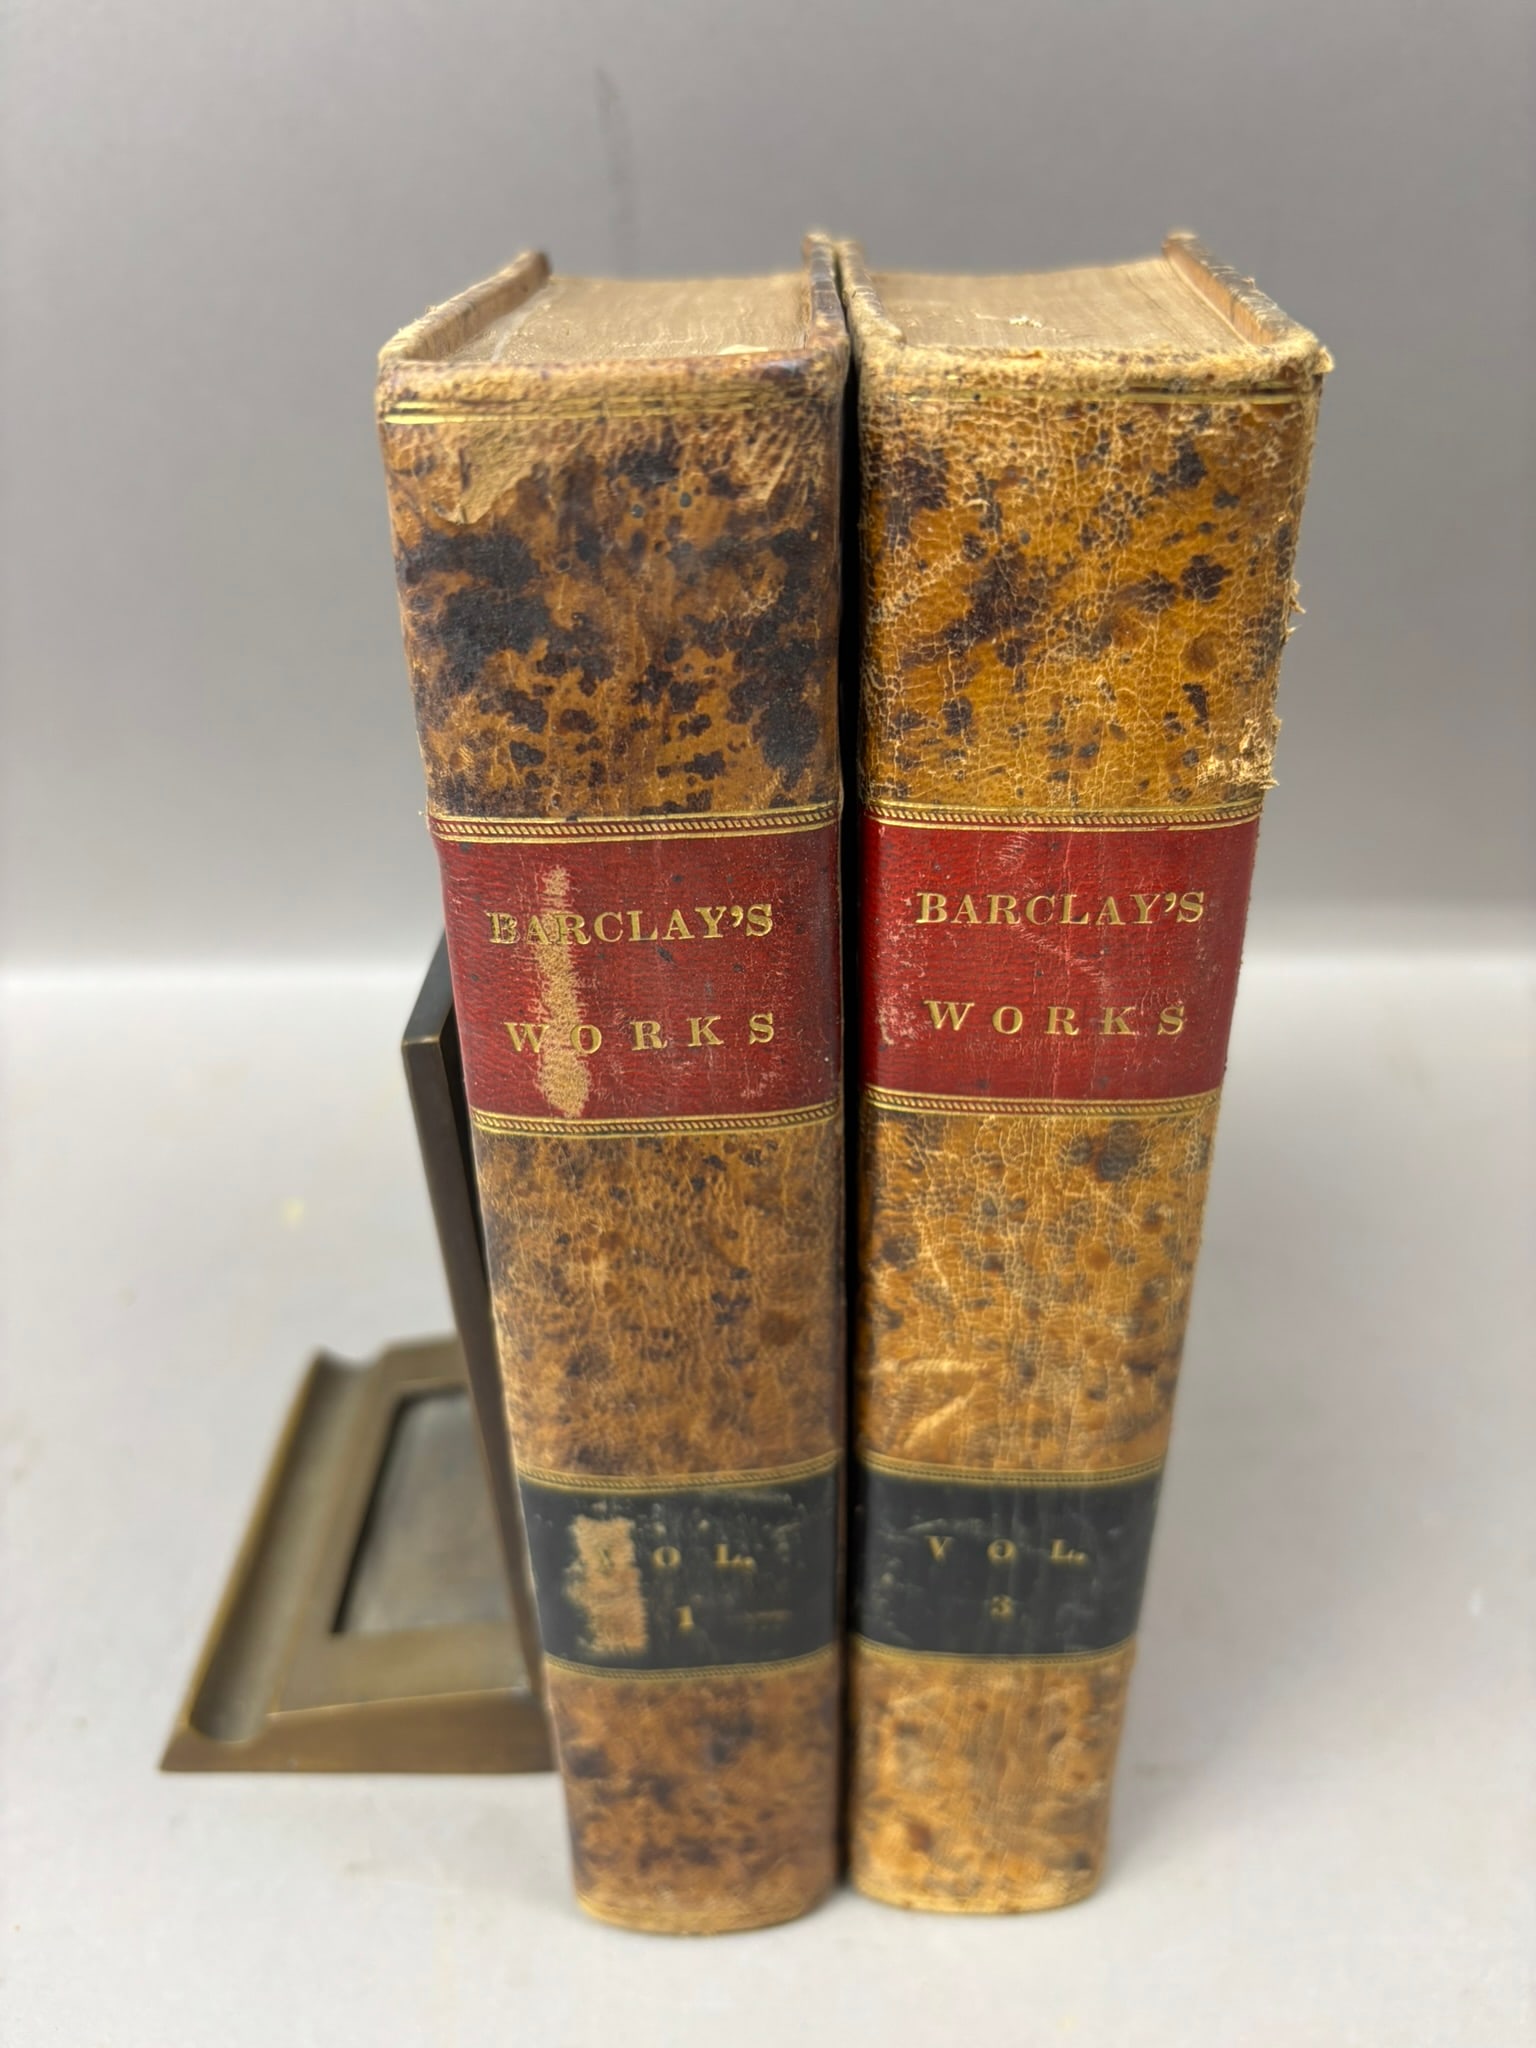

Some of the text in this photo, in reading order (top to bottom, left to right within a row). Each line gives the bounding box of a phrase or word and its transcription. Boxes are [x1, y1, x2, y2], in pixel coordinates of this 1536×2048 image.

[486, 902, 774, 945] BARCLAY'S
[915, 891, 1205, 926] BARCLAY'S
[503, 1012, 775, 1056] WORKS
[923, 1000, 1188, 1037] WORKS
